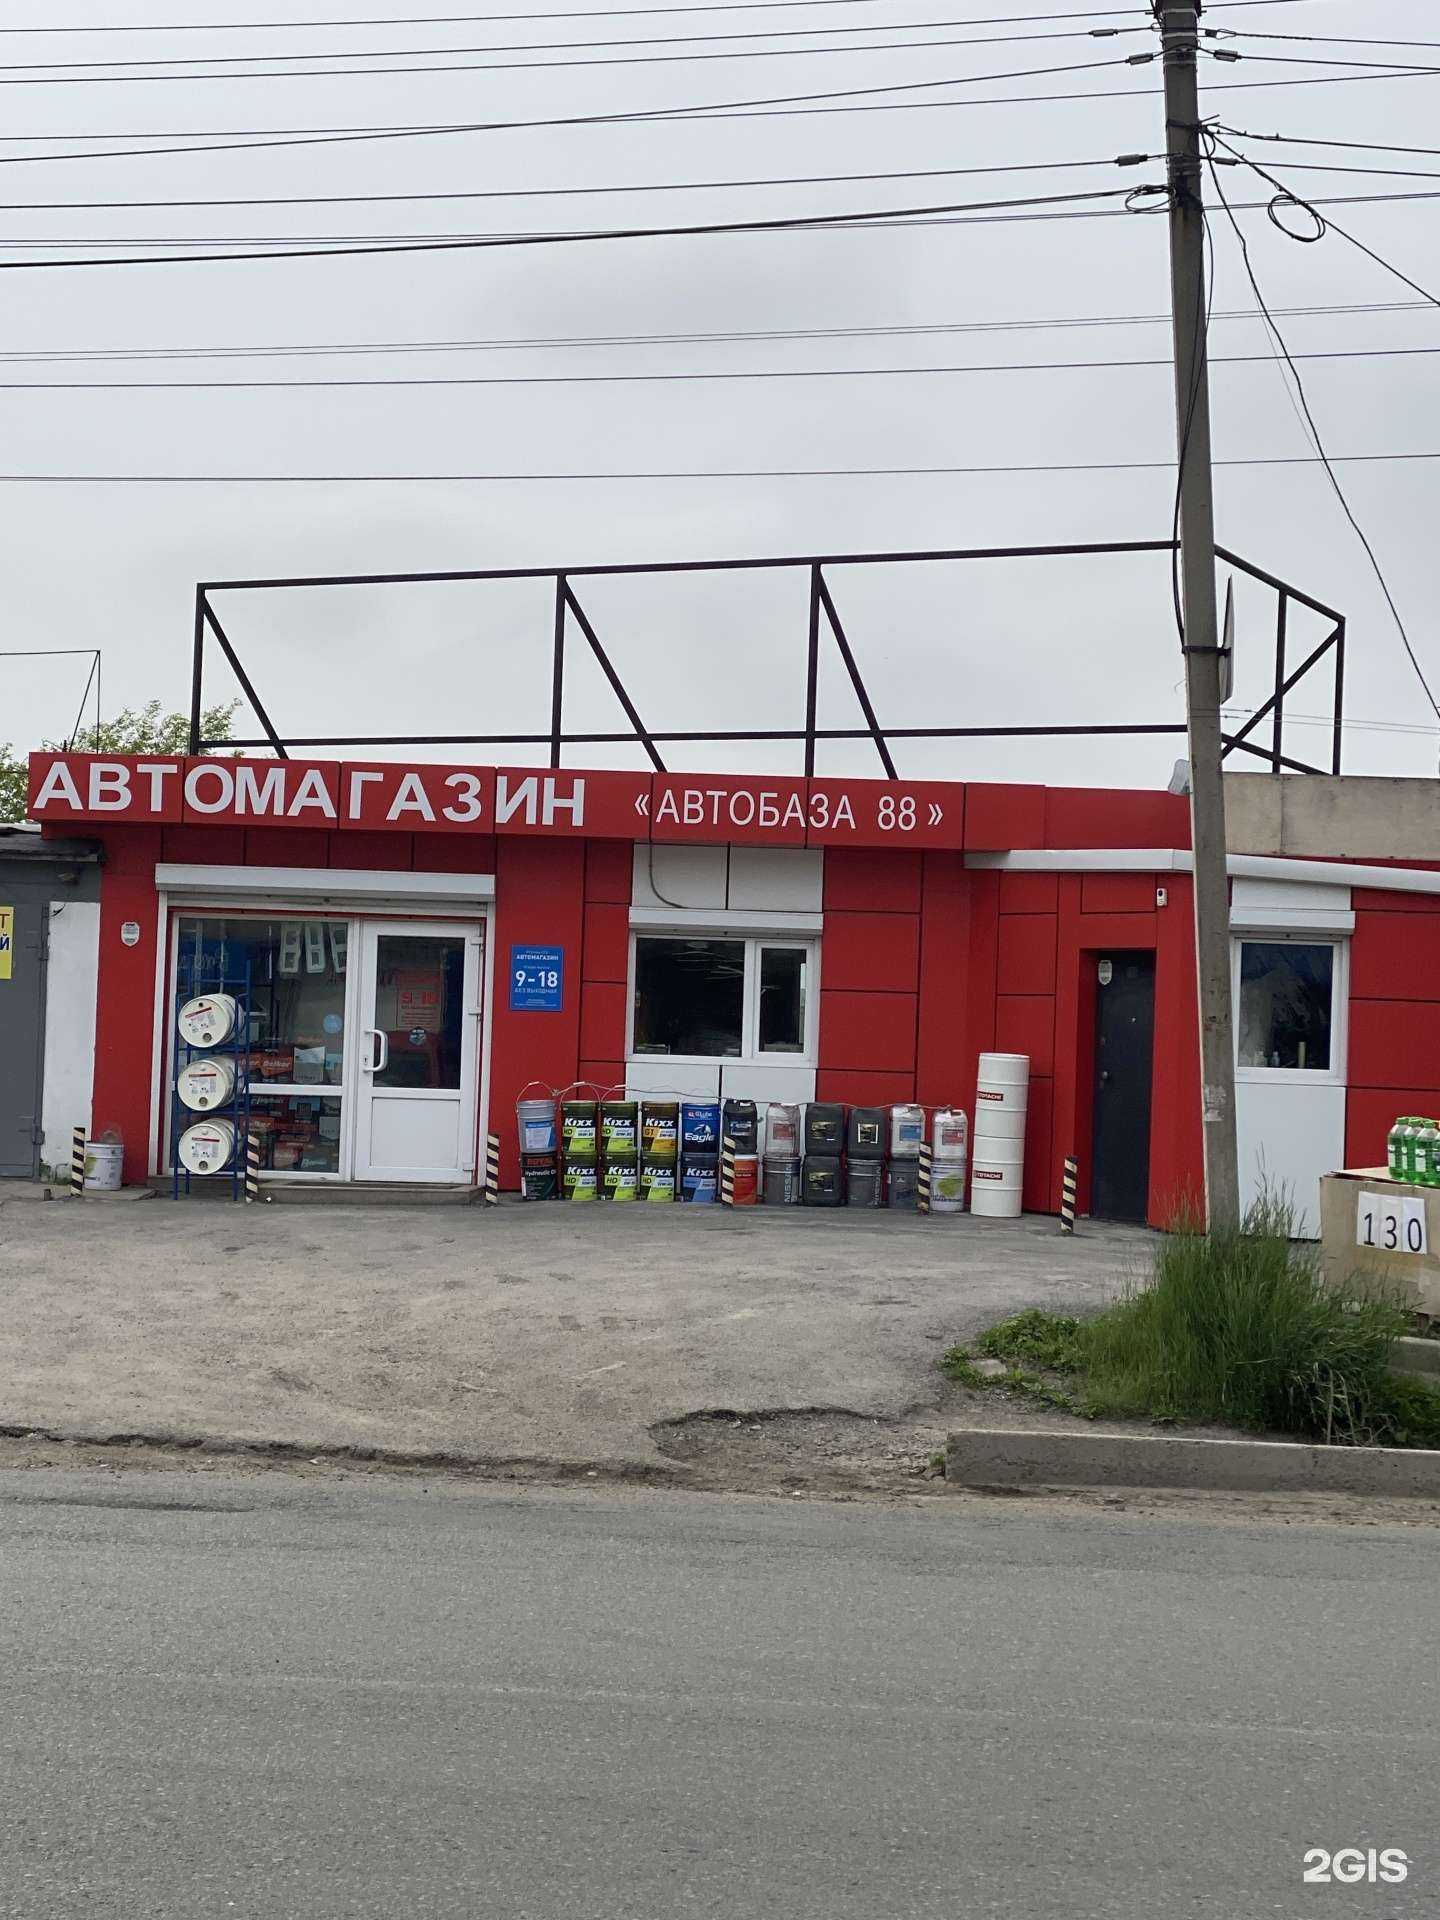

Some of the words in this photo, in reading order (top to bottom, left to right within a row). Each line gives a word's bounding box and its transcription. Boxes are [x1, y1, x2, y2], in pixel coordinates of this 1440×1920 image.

[33, 760, 585, 827] АВТОМАГАЗИН
[515, 970, 558, 987] 9-18
[564, 1117, 593, 1127] Kixx
[603, 1117, 632, 1127] Kixx
[645, 1117, 674, 1127] Kixx
[685, 1132, 715, 1143] Eagle
[567, 1166, 595, 1175] Kixx
[608, 1166, 636, 1176] Kixx
[644, 1166, 673, 1177] Kixx
[686, 1167, 715, 1177] Kixx
[565, 1176, 577, 1184] HD
[606, 1176, 618, 1185] HD
[784, 1163, 793, 1203] NISSAN
[1364, 1213, 1422, 1252] 130
